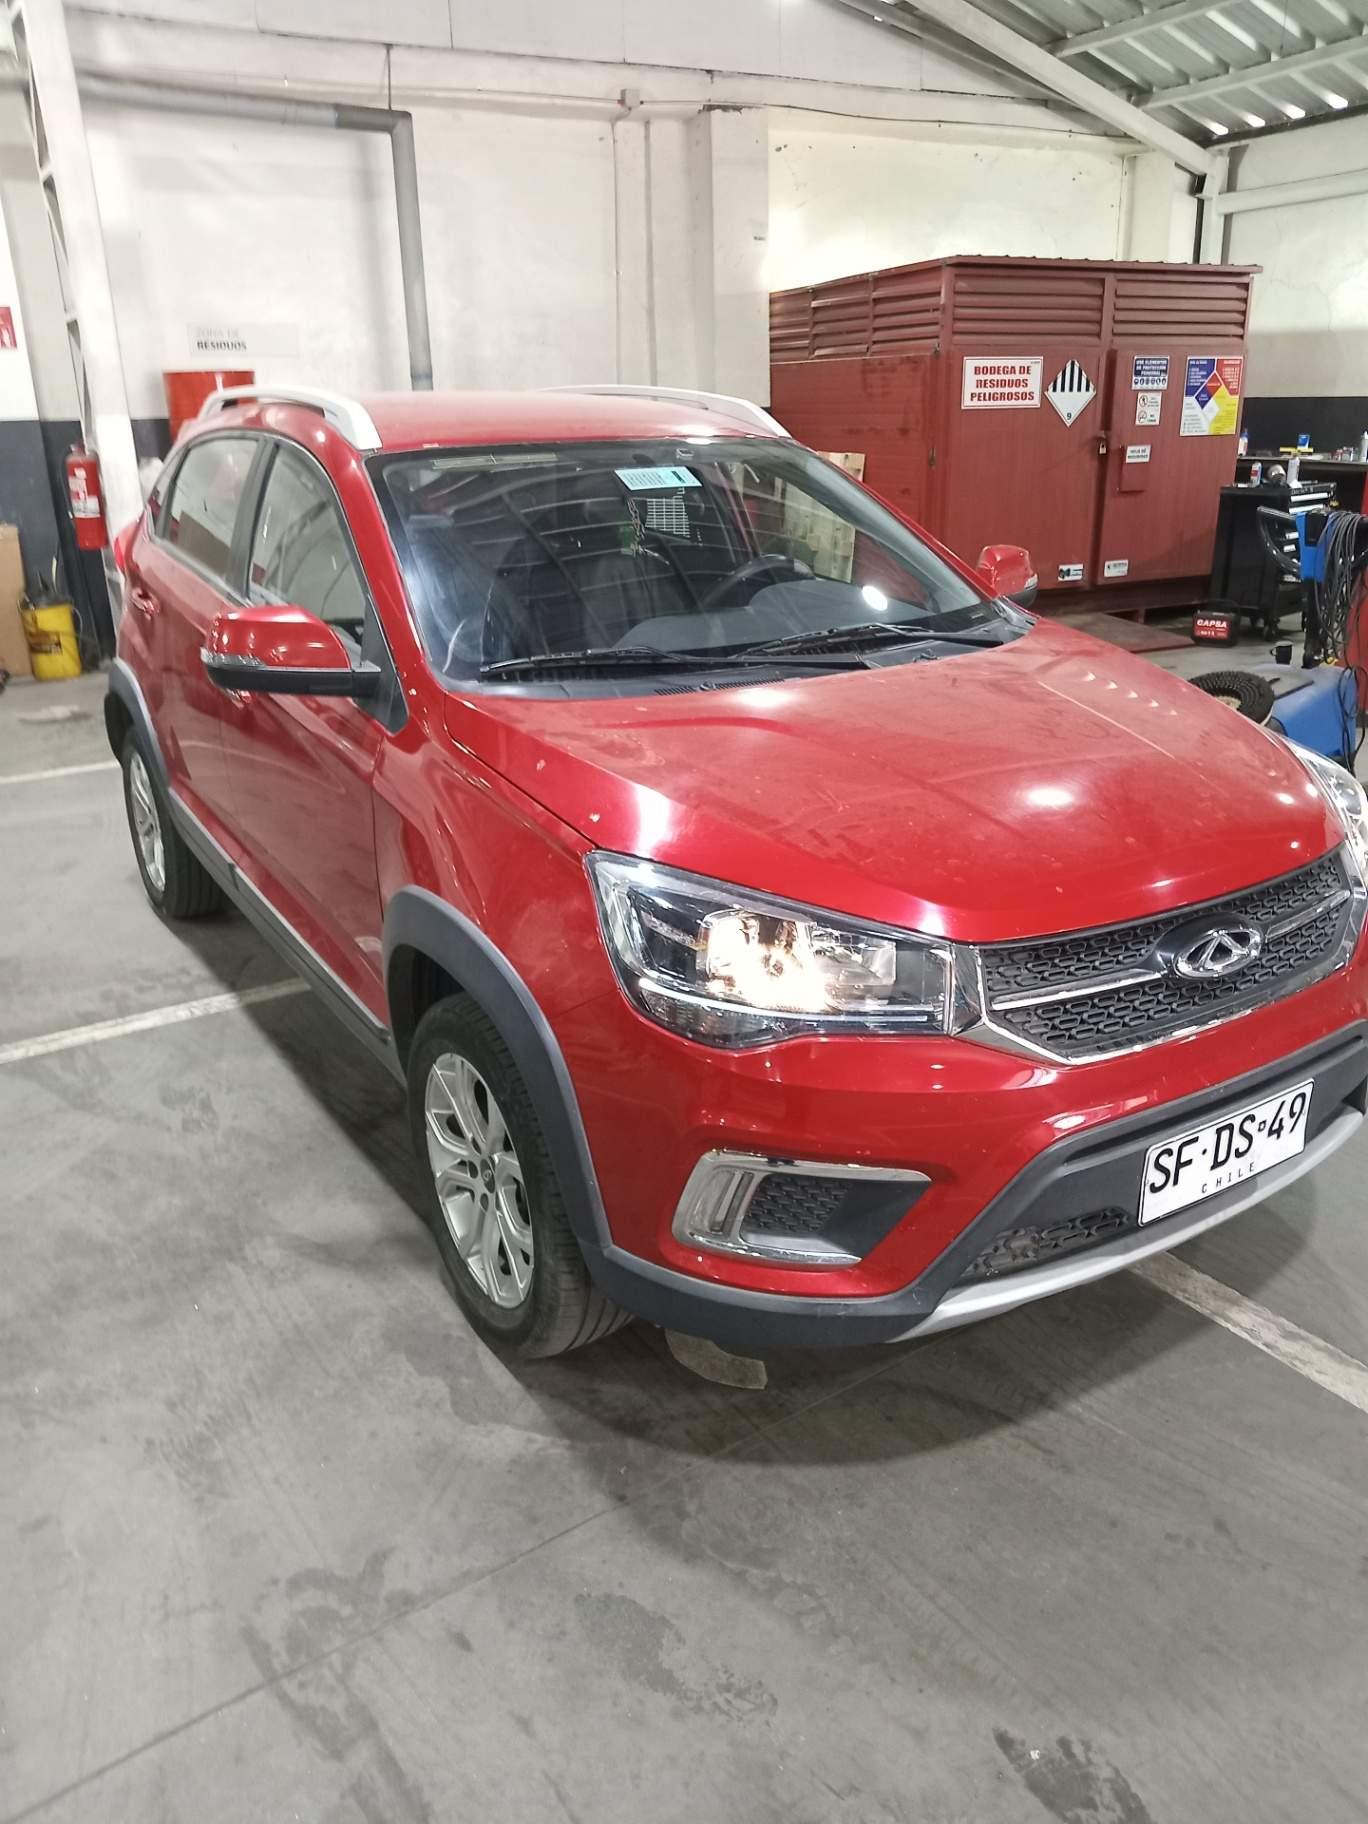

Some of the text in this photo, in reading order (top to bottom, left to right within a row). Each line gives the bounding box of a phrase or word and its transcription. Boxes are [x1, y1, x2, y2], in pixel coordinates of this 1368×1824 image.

[197, 340, 247, 351] RESIDUOS
[974, 366, 1032, 375] BODEGA DE
[975, 378, 1029, 389] RESIDUOS
[970, 391, 1035, 402] PELIGROSOS
[1066, 412, 1073, 421] 9
[1201, 1161, 1255, 1194] CHILE
